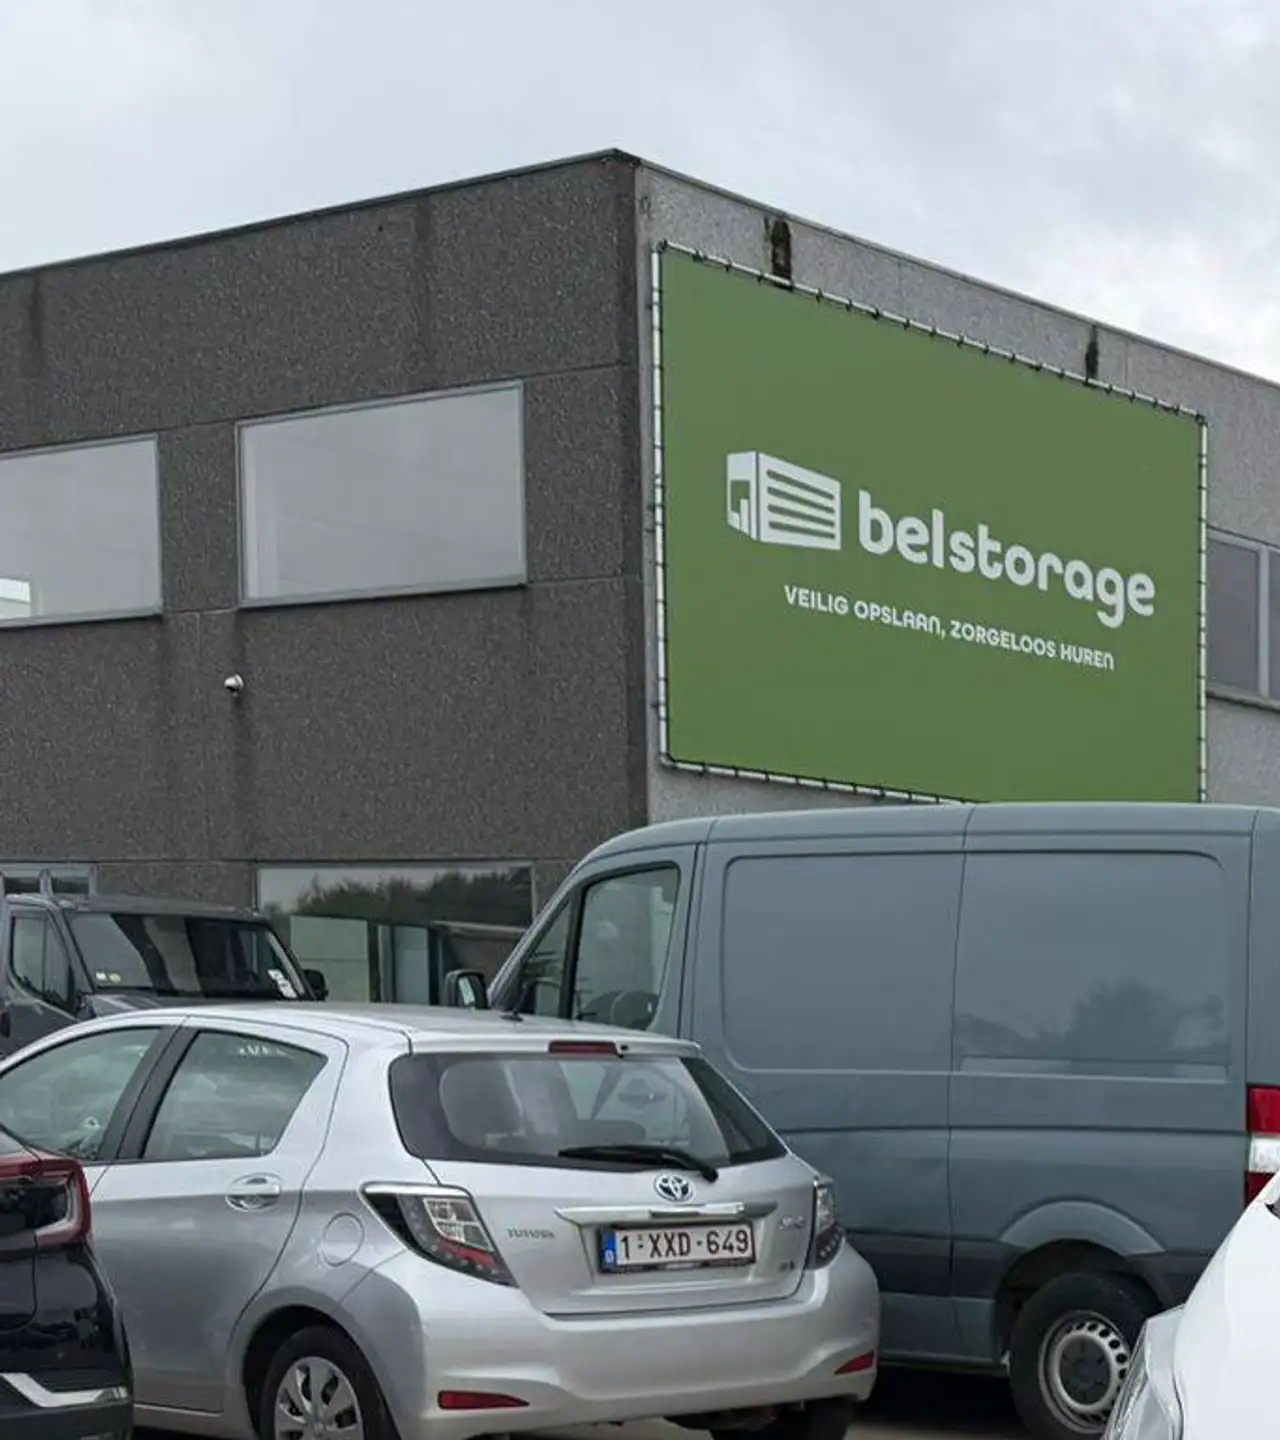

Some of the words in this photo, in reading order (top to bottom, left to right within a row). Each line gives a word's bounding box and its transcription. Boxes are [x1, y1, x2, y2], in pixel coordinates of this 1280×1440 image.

[859, 490, 1155, 628] belstorage
[784, 584, 849, 615] VEILIG
[854, 600, 946, 640] OPSLAAN,
[950, 620, 1056, 658] ZORGELOOS
[1060, 643, 1114, 670] HUREN
[620, 1228, 750, 1260] 1-XXD-649
